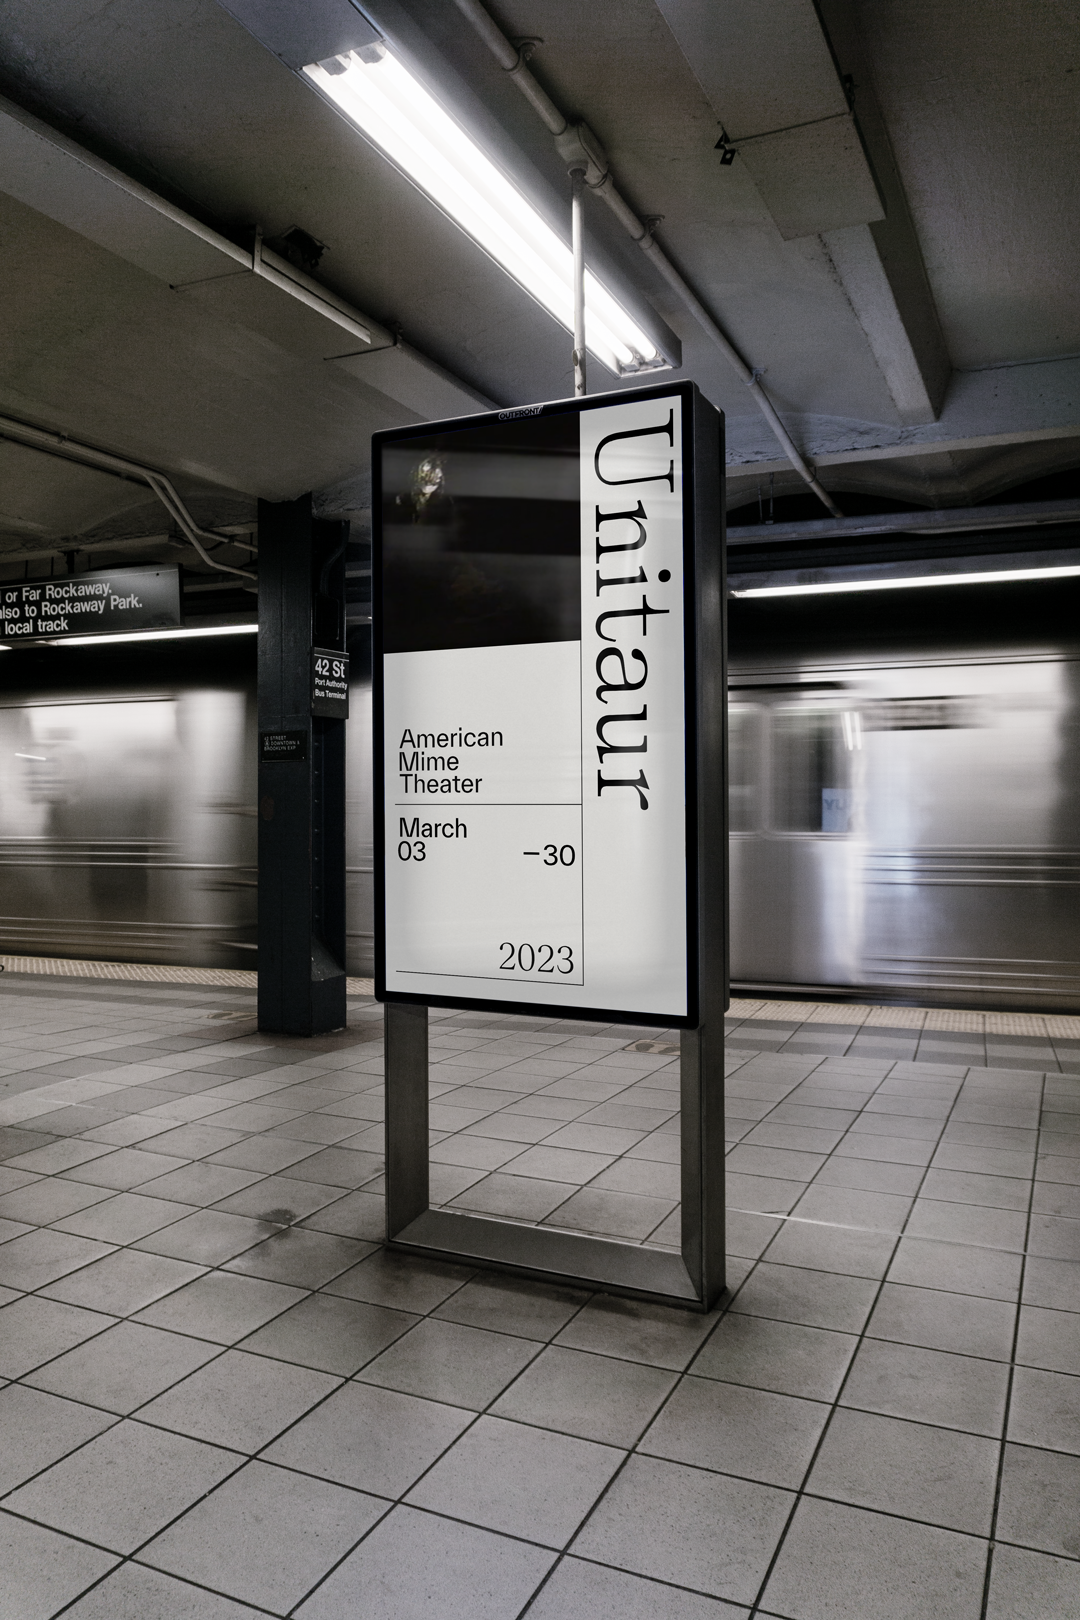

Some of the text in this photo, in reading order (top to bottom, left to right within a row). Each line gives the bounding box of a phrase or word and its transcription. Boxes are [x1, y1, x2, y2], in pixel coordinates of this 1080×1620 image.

[5, 591, 18, 603] or
[22, 587, 41, 602] Far
[45, 582, 112, 600] Rockaway.
[24, 603, 37, 617] to
[41, 599, 105, 616] Rockaway
[110, 593, 143, 610] Park.
[594, 408, 674, 810] Unitaur
[4, 618, 33, 635] local
[37, 616, 69, 632] track
[314, 658, 345, 679] 42 St
[314, 677, 348, 691] Port Authority
[314, 688, 346, 700] Bus Terminal
[399, 727, 503, 748] American
[399, 752, 459, 771] Mime
[399, 774, 483, 793] Theater
[399, 818, 467, 838] March
[397, 841, 427, 861] 03
[499, 942, 574, 975] 2023
